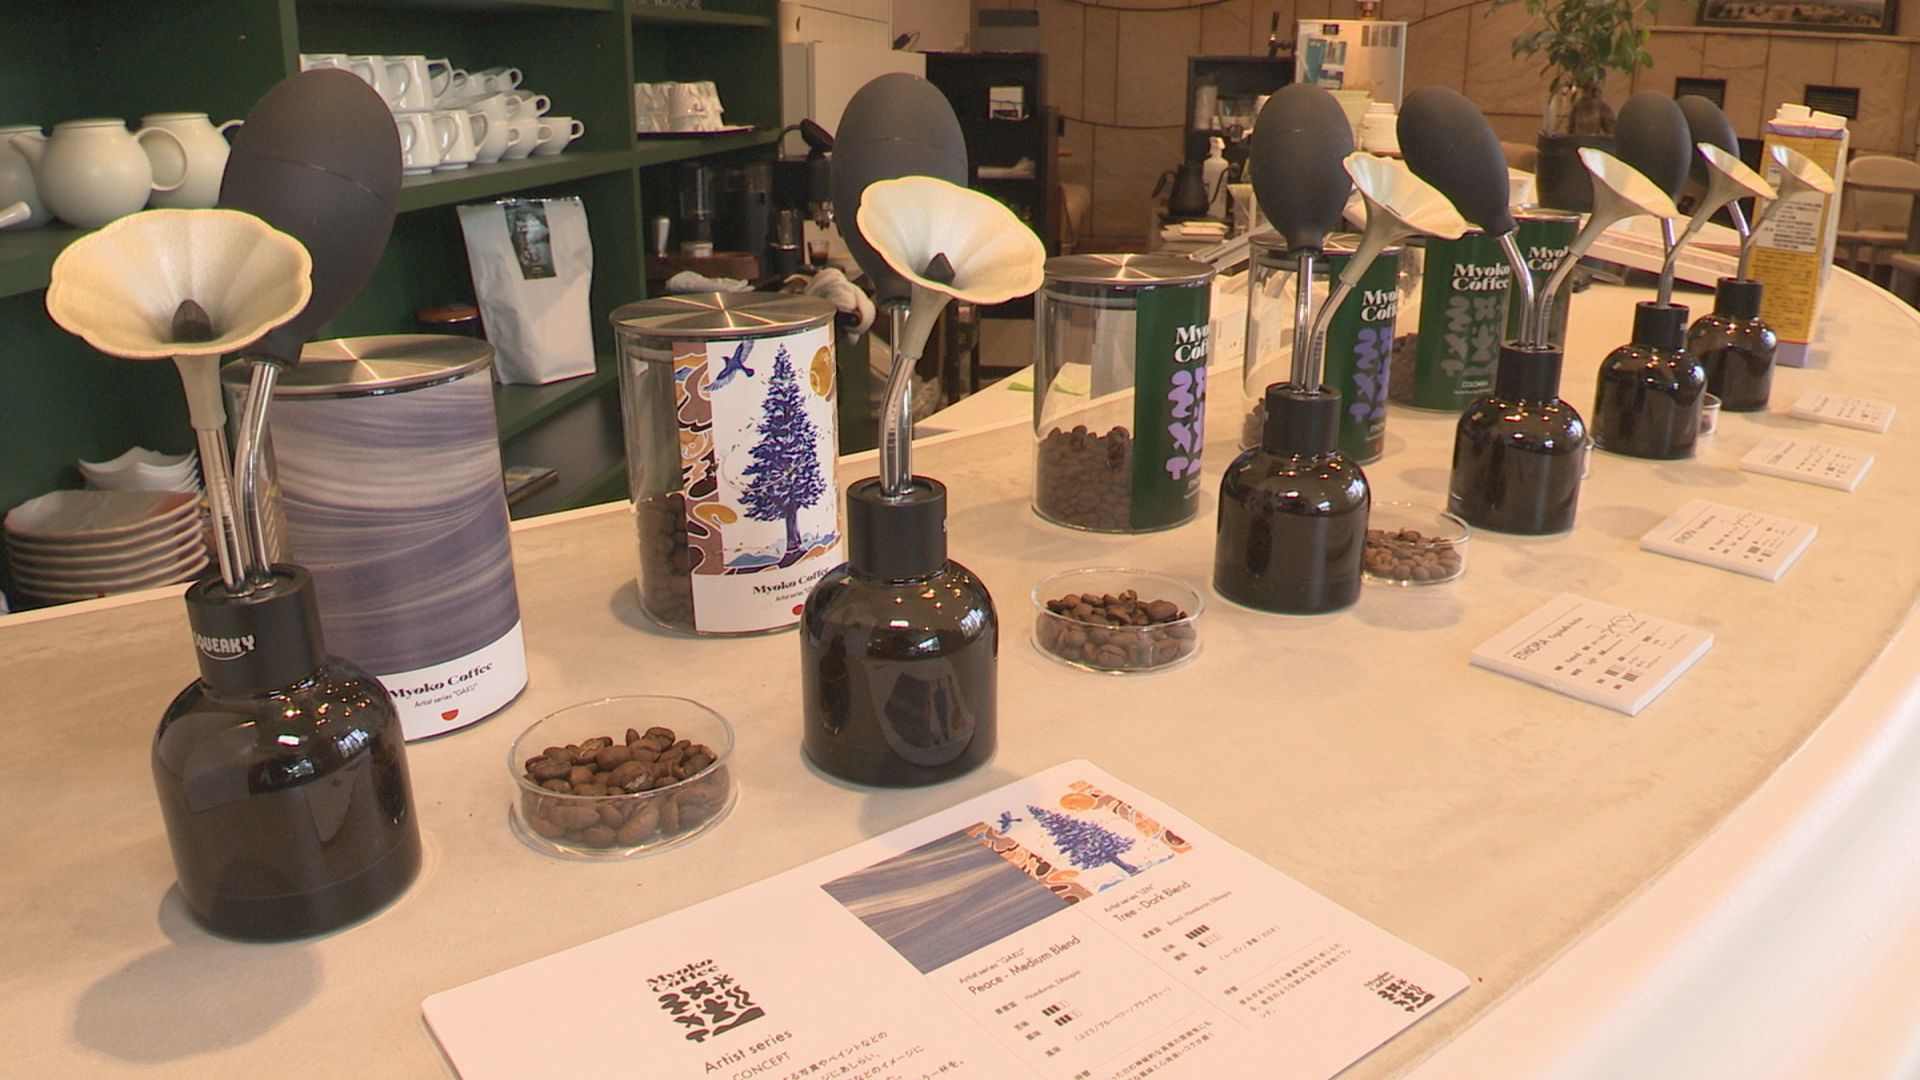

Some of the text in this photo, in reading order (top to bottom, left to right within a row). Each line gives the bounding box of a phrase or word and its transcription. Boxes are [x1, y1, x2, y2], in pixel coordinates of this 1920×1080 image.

[1453, 262, 1511, 280] Myoko
[1528, 259, 1564, 271] Cof
[1452, 276, 1509, 291] Coffee
[753, 581, 797, 596] Myoko
[388, 662, 493, 700] Myoko Coffee
[1113, 910, 1137, 922] Tree
[1139, 894, 1167, 909] Dark
[1162, 880, 1191, 897] Blend
[646, 959, 713, 986] Myoko
[652, 965, 720, 992] Coffee
[968, 976, 1003, 995] Peace
[1008, 952, 1053, 976] Medium
[1049, 935, 1081, 955] Blend
[704, 1030, 793, 1074] Artist series
[733, 1051, 791, 1080] CONCEPT
